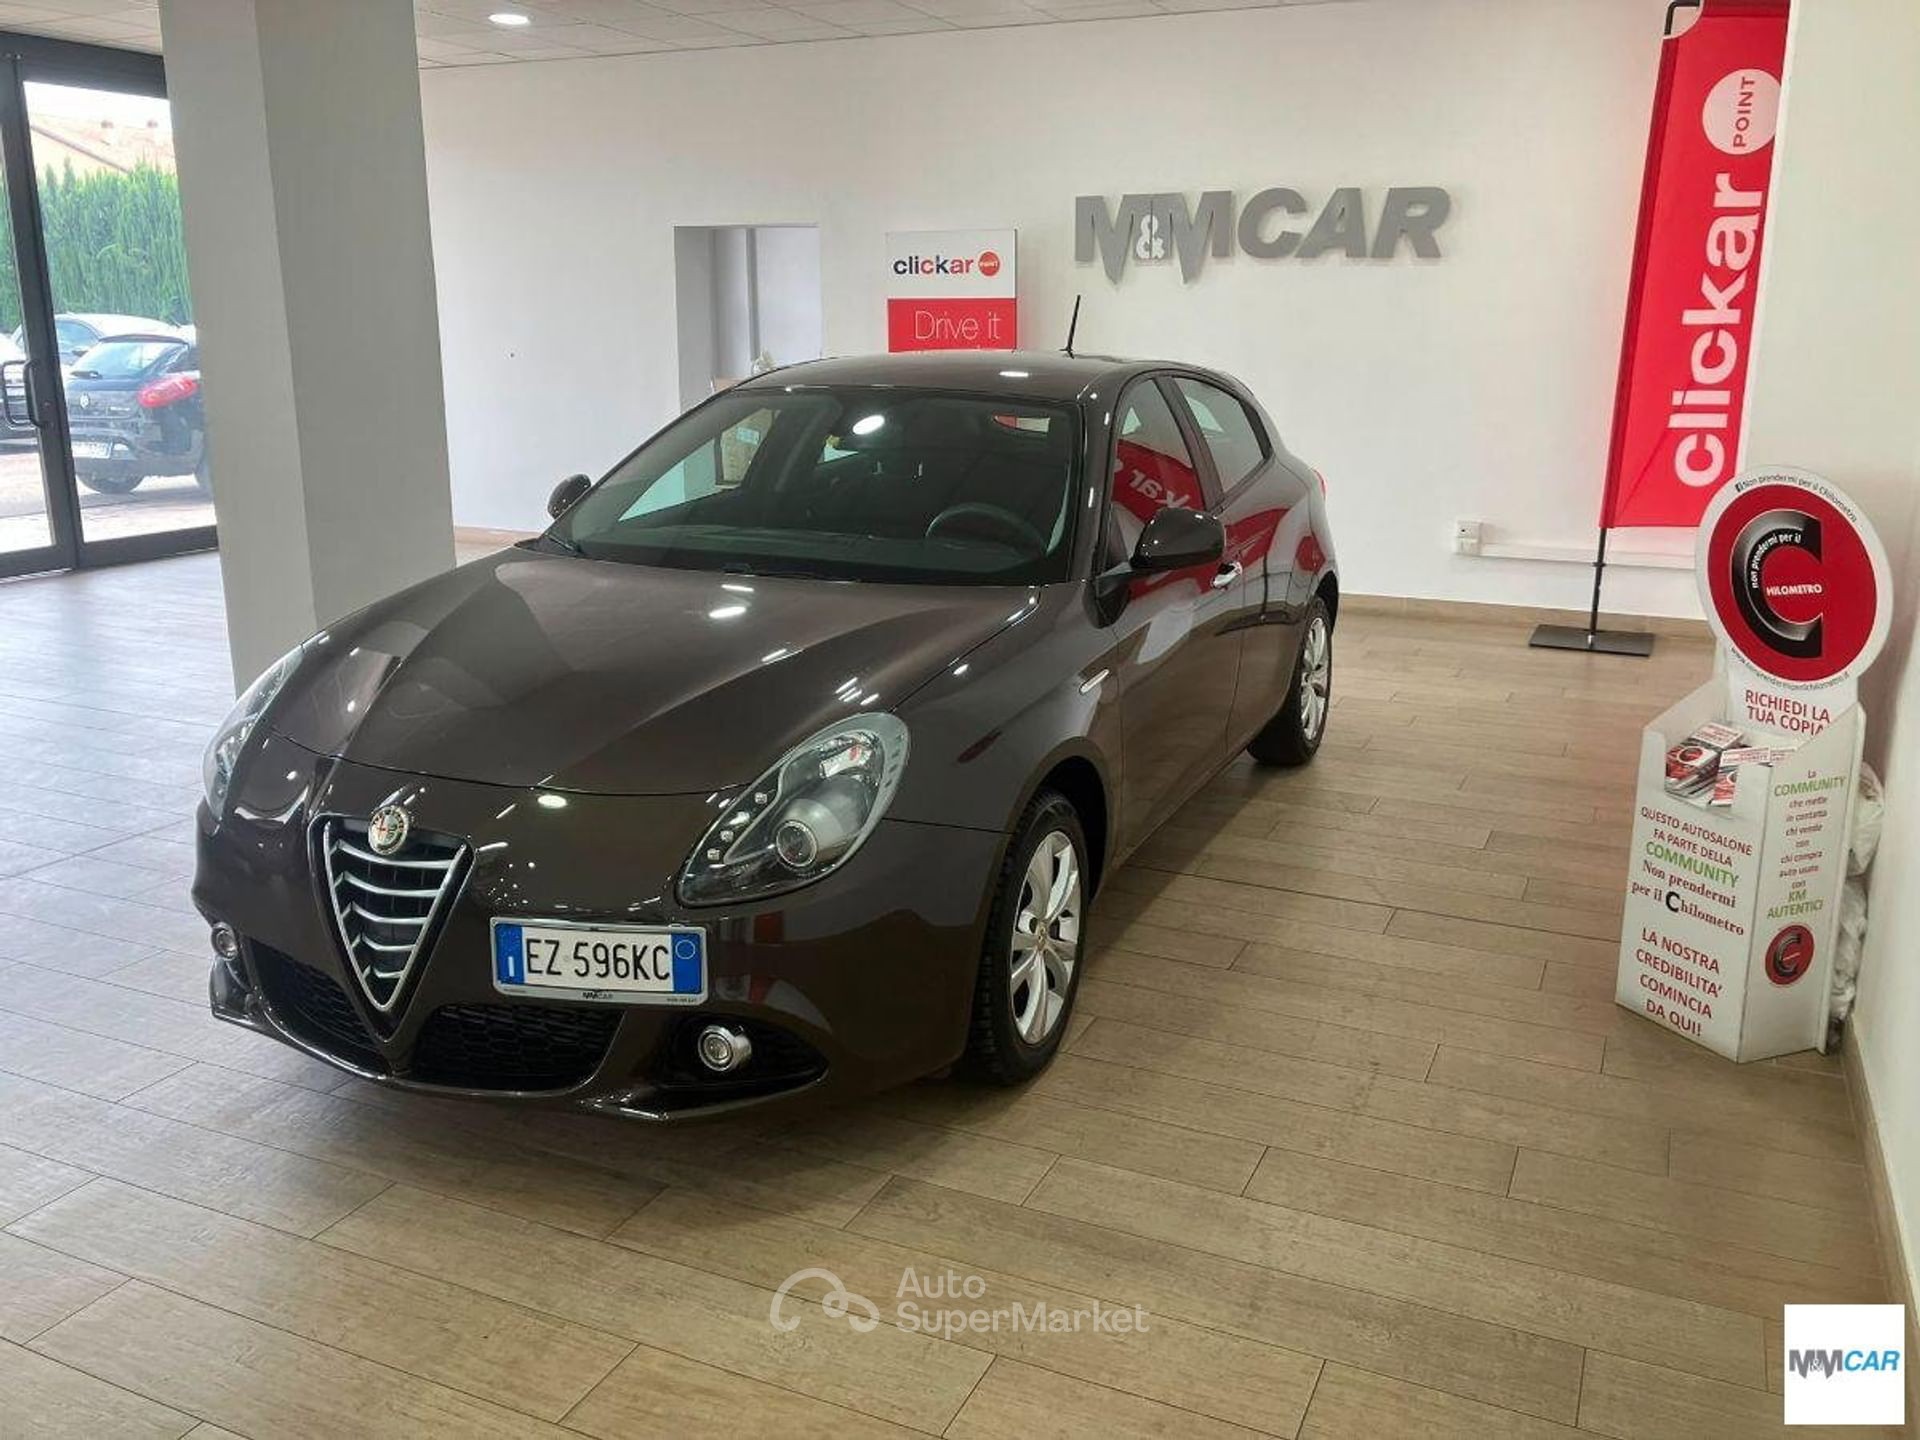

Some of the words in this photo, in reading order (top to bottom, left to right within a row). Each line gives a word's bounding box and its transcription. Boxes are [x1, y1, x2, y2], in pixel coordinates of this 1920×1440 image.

[1733, 76, 1755, 148] POINT
[893, 255, 974, 275] clickar
[915, 309, 979, 341] Drive
[988, 310, 1002, 340] it
[1669, 172, 1764, 488] clickar
[1745, 689, 1807, 717] RICHIEDI
[1812, 706, 1831, 724] LA
[1747, 705, 1775, 726] TUA
[1774, 775, 1846, 797] COMMUNITY
[1641, 806, 1680, 829] QUESTO
[1682, 822, 1753, 857] AUTOSALONE
[1653, 828, 1666, 841] FA
[1667, 834, 1698, 855] PARTE
[1700, 846, 1733, 867] DELLA
[1643, 860, 1666, 880] Non
[1668, 874, 1737, 909] prendermi
[1646, 841, 1740, 889] COMMUNITY
[1632, 882, 1651, 896] per
[1653, 888, 1663, 902] il
[1665, 890, 1745, 937] Chilometro
[525, 938, 562, 976] EZ
[572, 941, 670, 981] 596KC
[1642, 927, 1658, 946] LA
[1661, 936, 1720, 975] NOSTRA
[1640, 974, 1712, 1019] COMINCIA
[1646, 999, 1666, 1019] DA
[1669, 1011, 1702, 1037] QUI!
